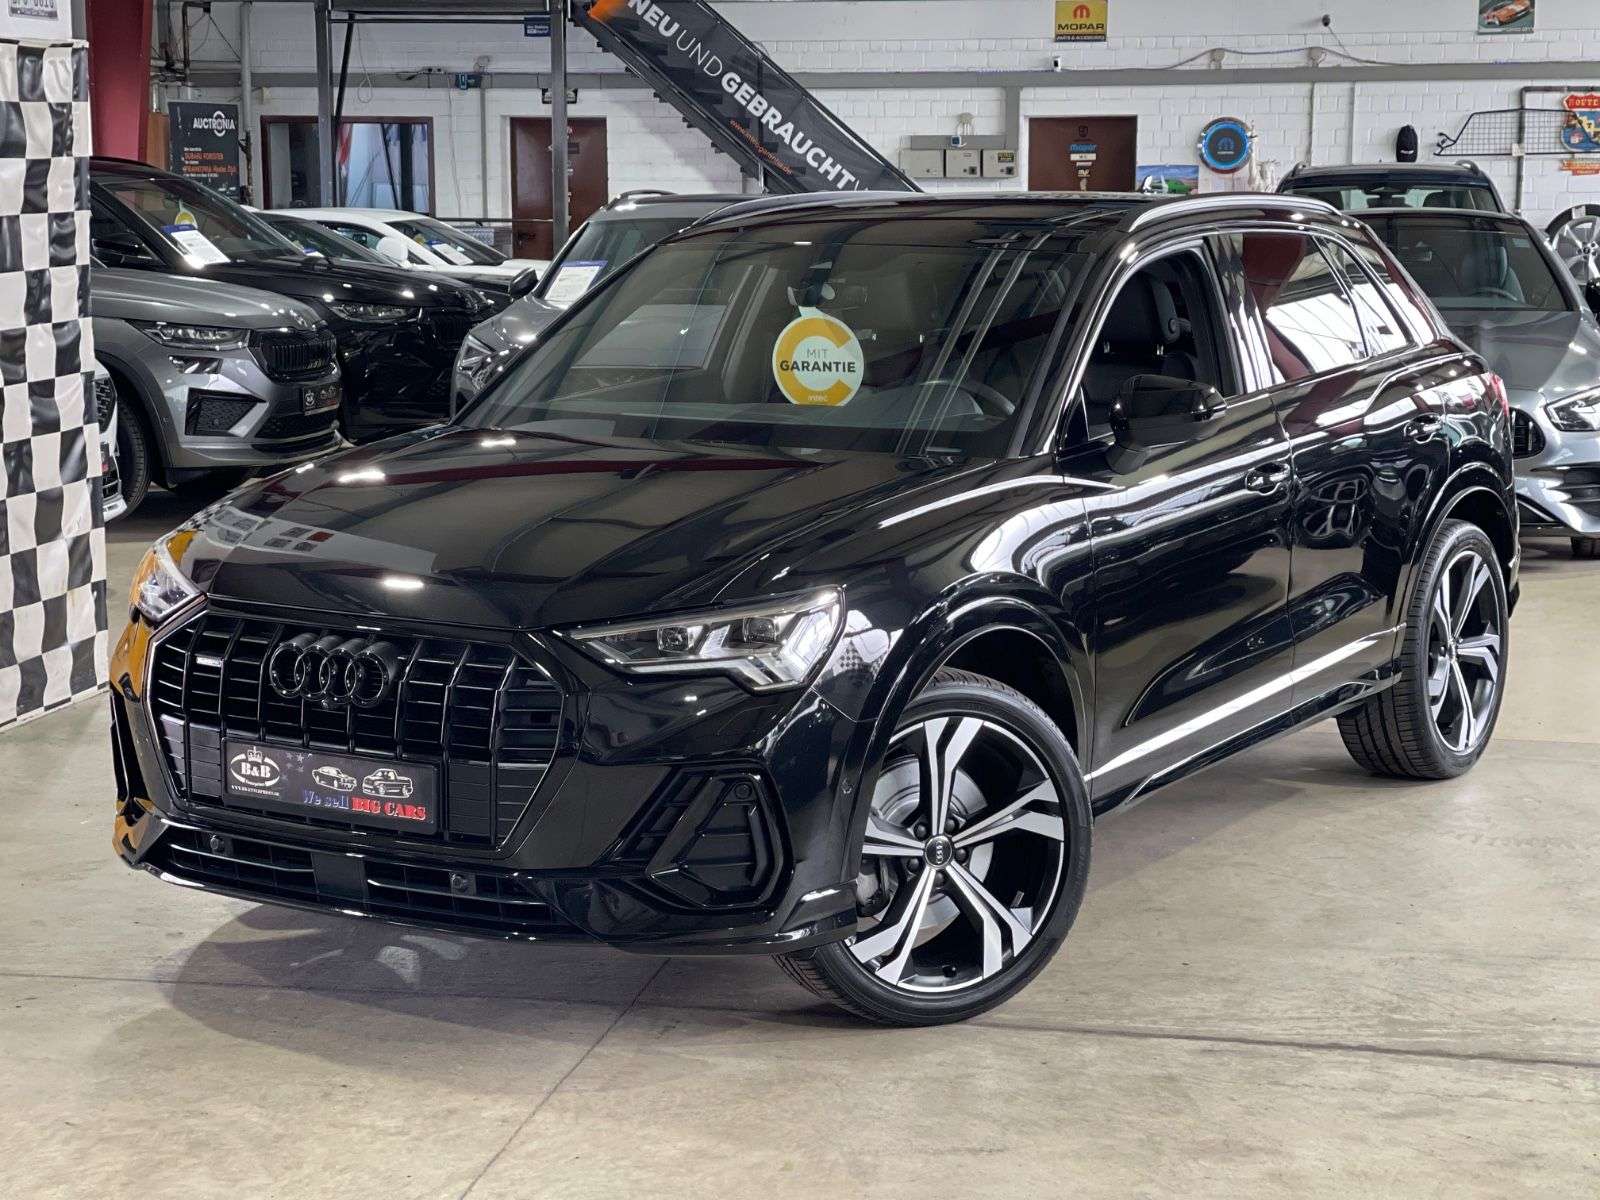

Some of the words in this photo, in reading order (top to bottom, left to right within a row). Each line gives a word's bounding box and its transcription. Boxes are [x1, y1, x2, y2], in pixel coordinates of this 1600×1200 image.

[1057, 23, 1105, 31] MOPAR
[628, 0, 680, 37] NEU
[676, 29, 723, 77] UND
[721, 71, 856, 190] GEBRAUCHT
[193, 114, 236, 133] AUCTRONIA
[806, 348, 828, 359] MIT
[779, 360, 857, 374] GARANTIE
[241, 762, 271, 778] B&B
[383, 801, 426, 821] CARS
